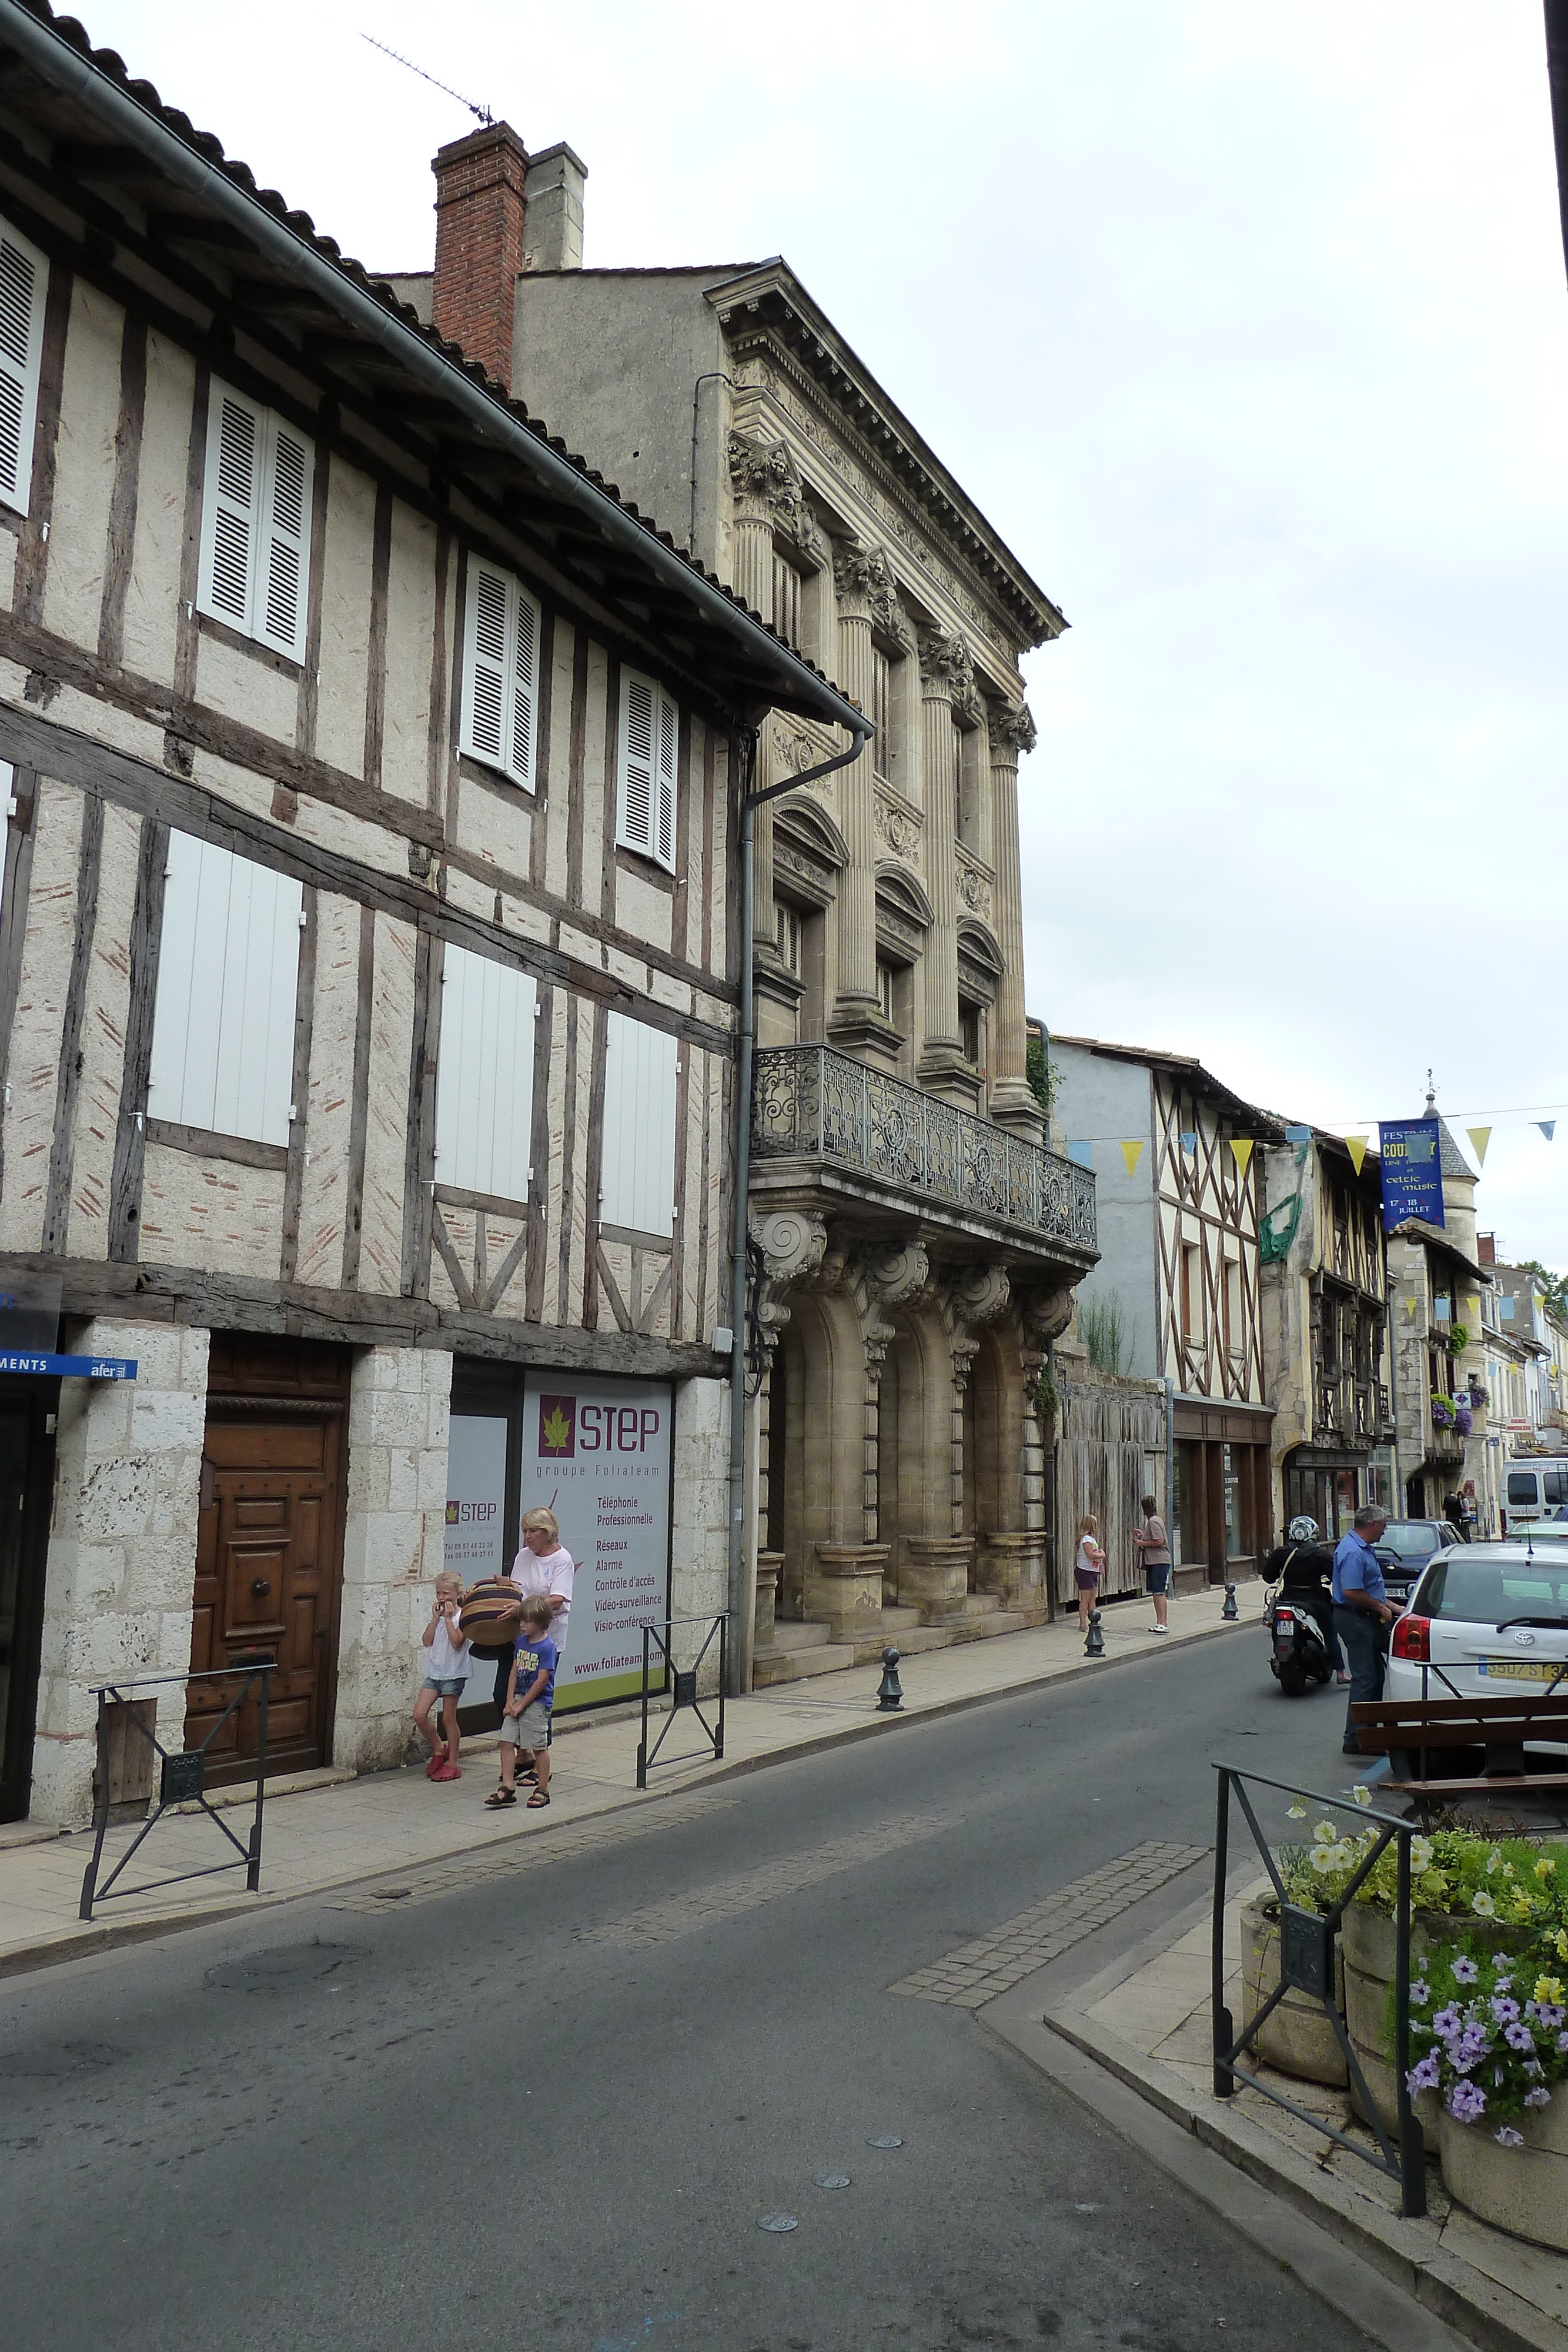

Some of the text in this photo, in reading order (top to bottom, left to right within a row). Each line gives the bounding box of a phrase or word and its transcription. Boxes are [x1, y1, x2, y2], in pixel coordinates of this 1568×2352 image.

[1402, 1182, 1437, 1191] music
[1399, 1206, 1430, 1214] JUILLET
[91, 1364, 116, 1377] afer
[536, 1465, 658, 1478] groupe Foliateam
[597, 1496, 638, 1511] Téléphonie
[597, 1512, 653, 1526] Professionnelle
[596, 1538, 628, 1552] Réseaux
[596, 1559, 623, 1571] Alarme
[595, 1573, 655, 1591] Contrôle d'accès
[595, 1595, 662, 1612] Vidéo-surveillance
[594, 1614, 655, 1632] Visio-conférence
